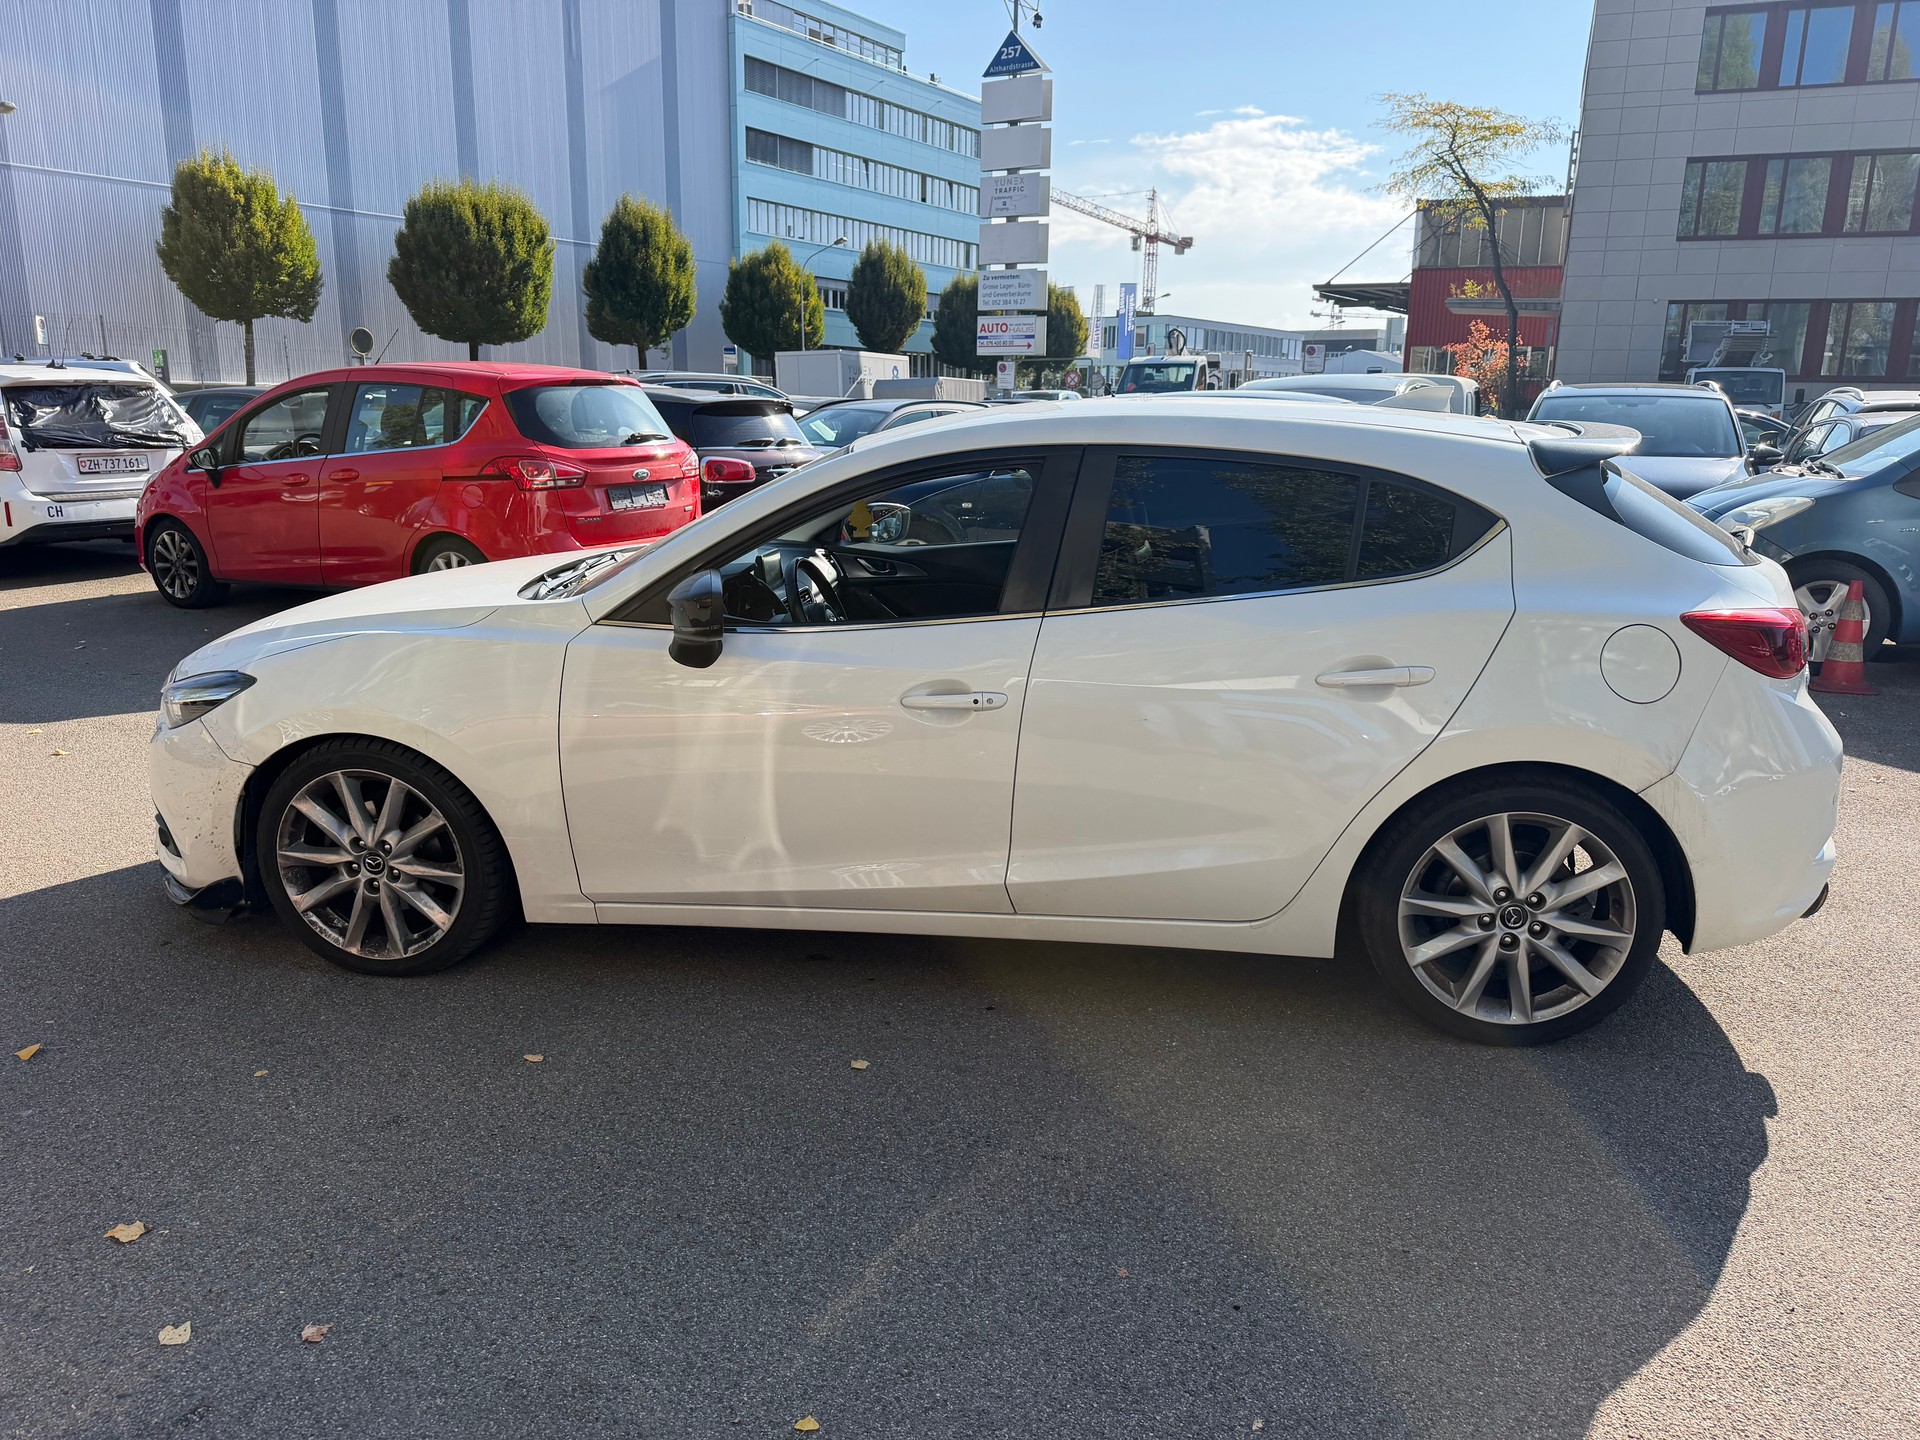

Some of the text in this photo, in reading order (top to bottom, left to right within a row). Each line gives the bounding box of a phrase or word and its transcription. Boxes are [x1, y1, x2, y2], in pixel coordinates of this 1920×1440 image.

[1001, 45, 1022, 59] 257
[989, 61, 1035, 73] Althardstrasse
[994, 176, 1025, 187] YUNEX
[994, 186, 1025, 194] TRAFFIC
[979, 322, 1009, 333] AUTO
[46, 505, 64, 518] CH
